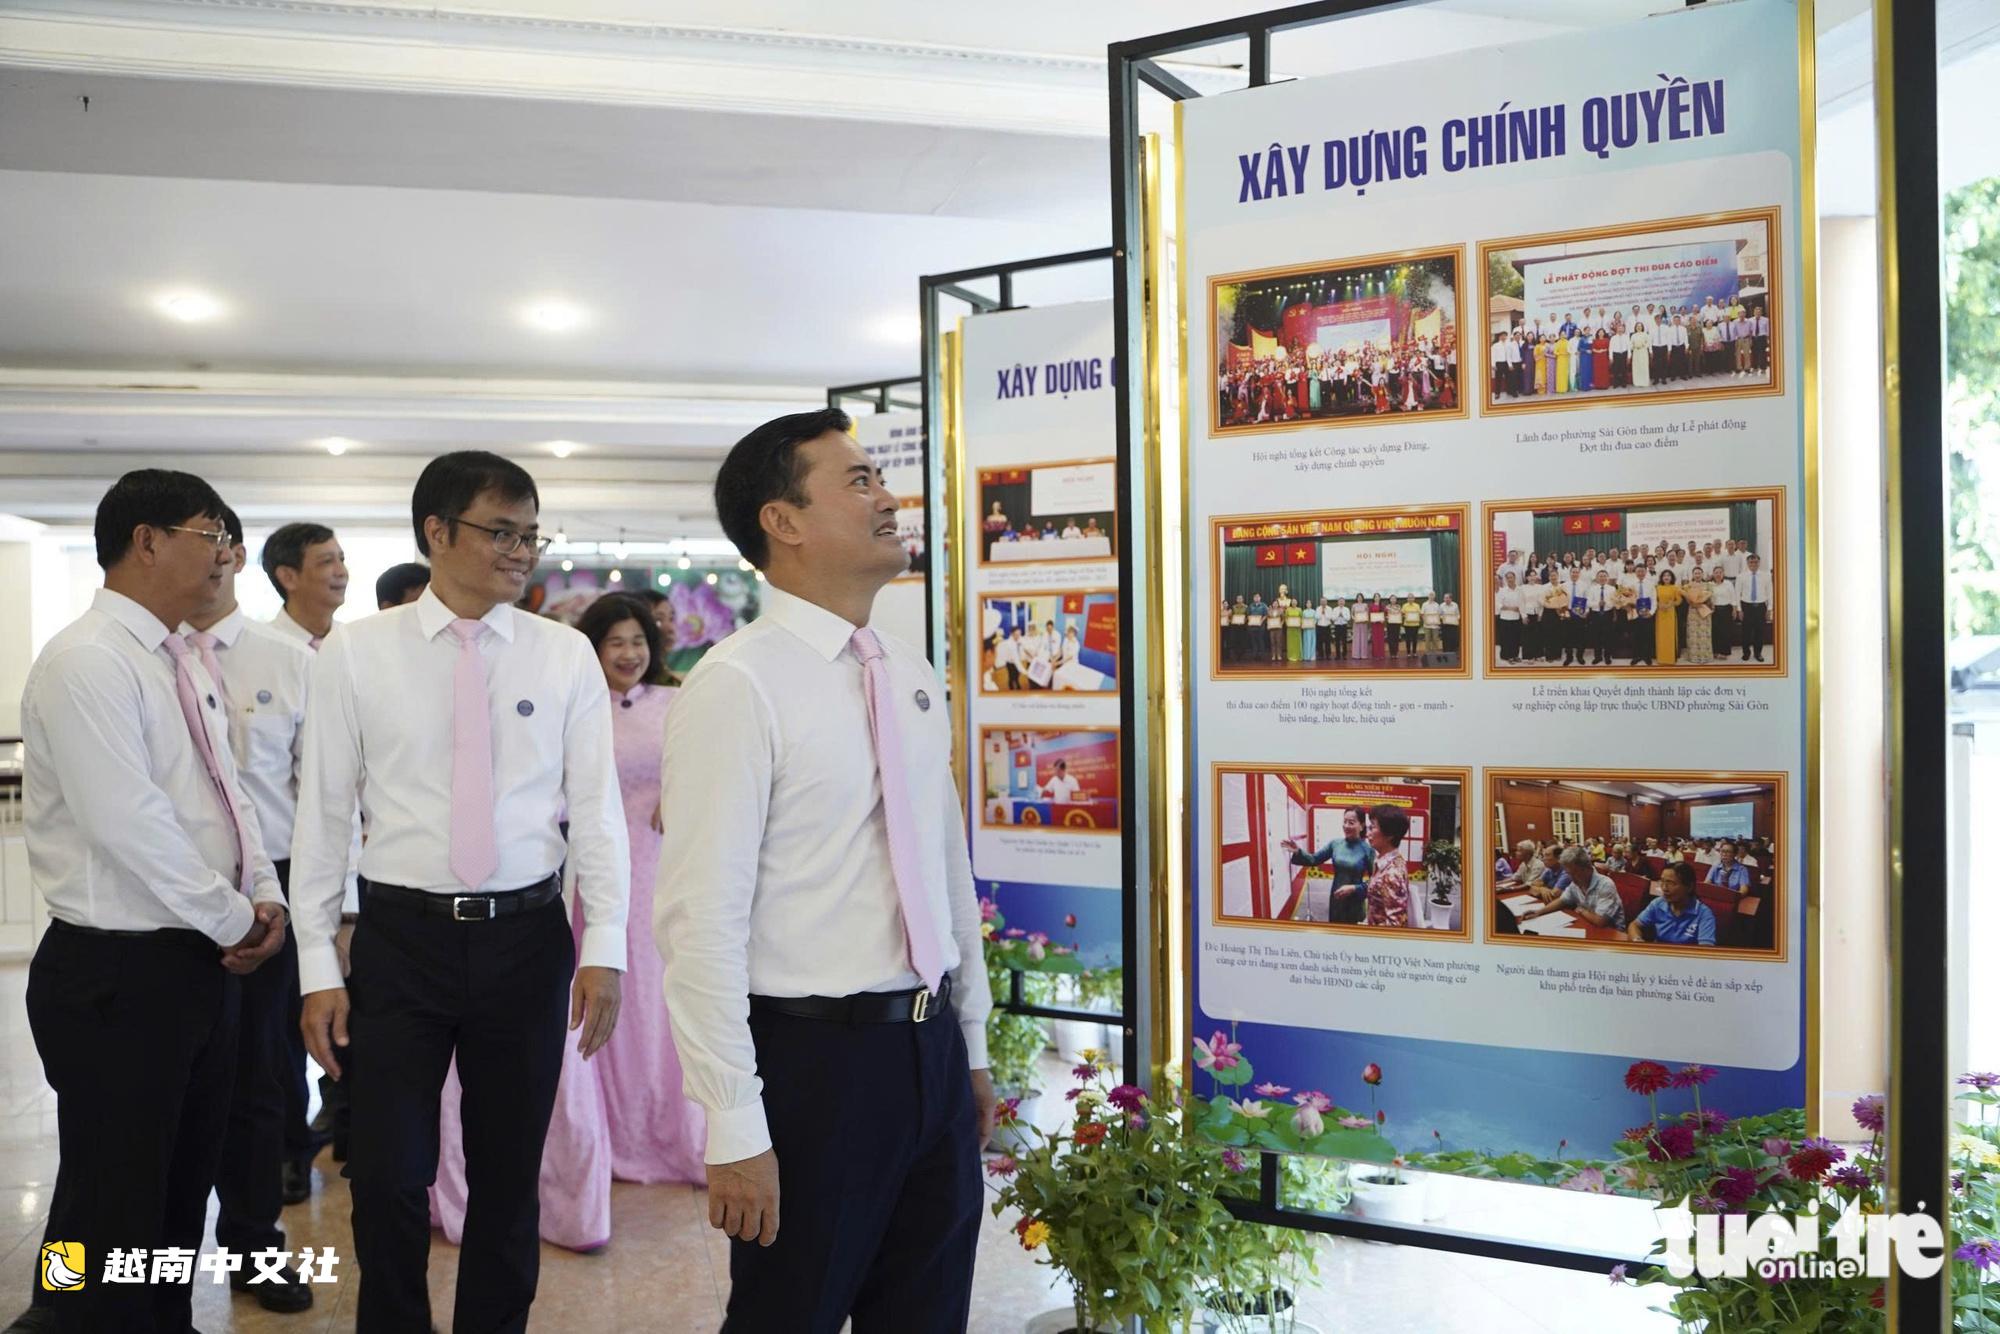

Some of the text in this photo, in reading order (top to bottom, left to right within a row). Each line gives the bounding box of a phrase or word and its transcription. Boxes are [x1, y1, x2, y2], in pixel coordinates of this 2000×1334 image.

[1238, 73, 1725, 203] XÂY DỰNG CHÍNH QUYỀN
[997, 363, 1037, 400] XÂY
[1046, 358, 1102, 399] DỰNG
